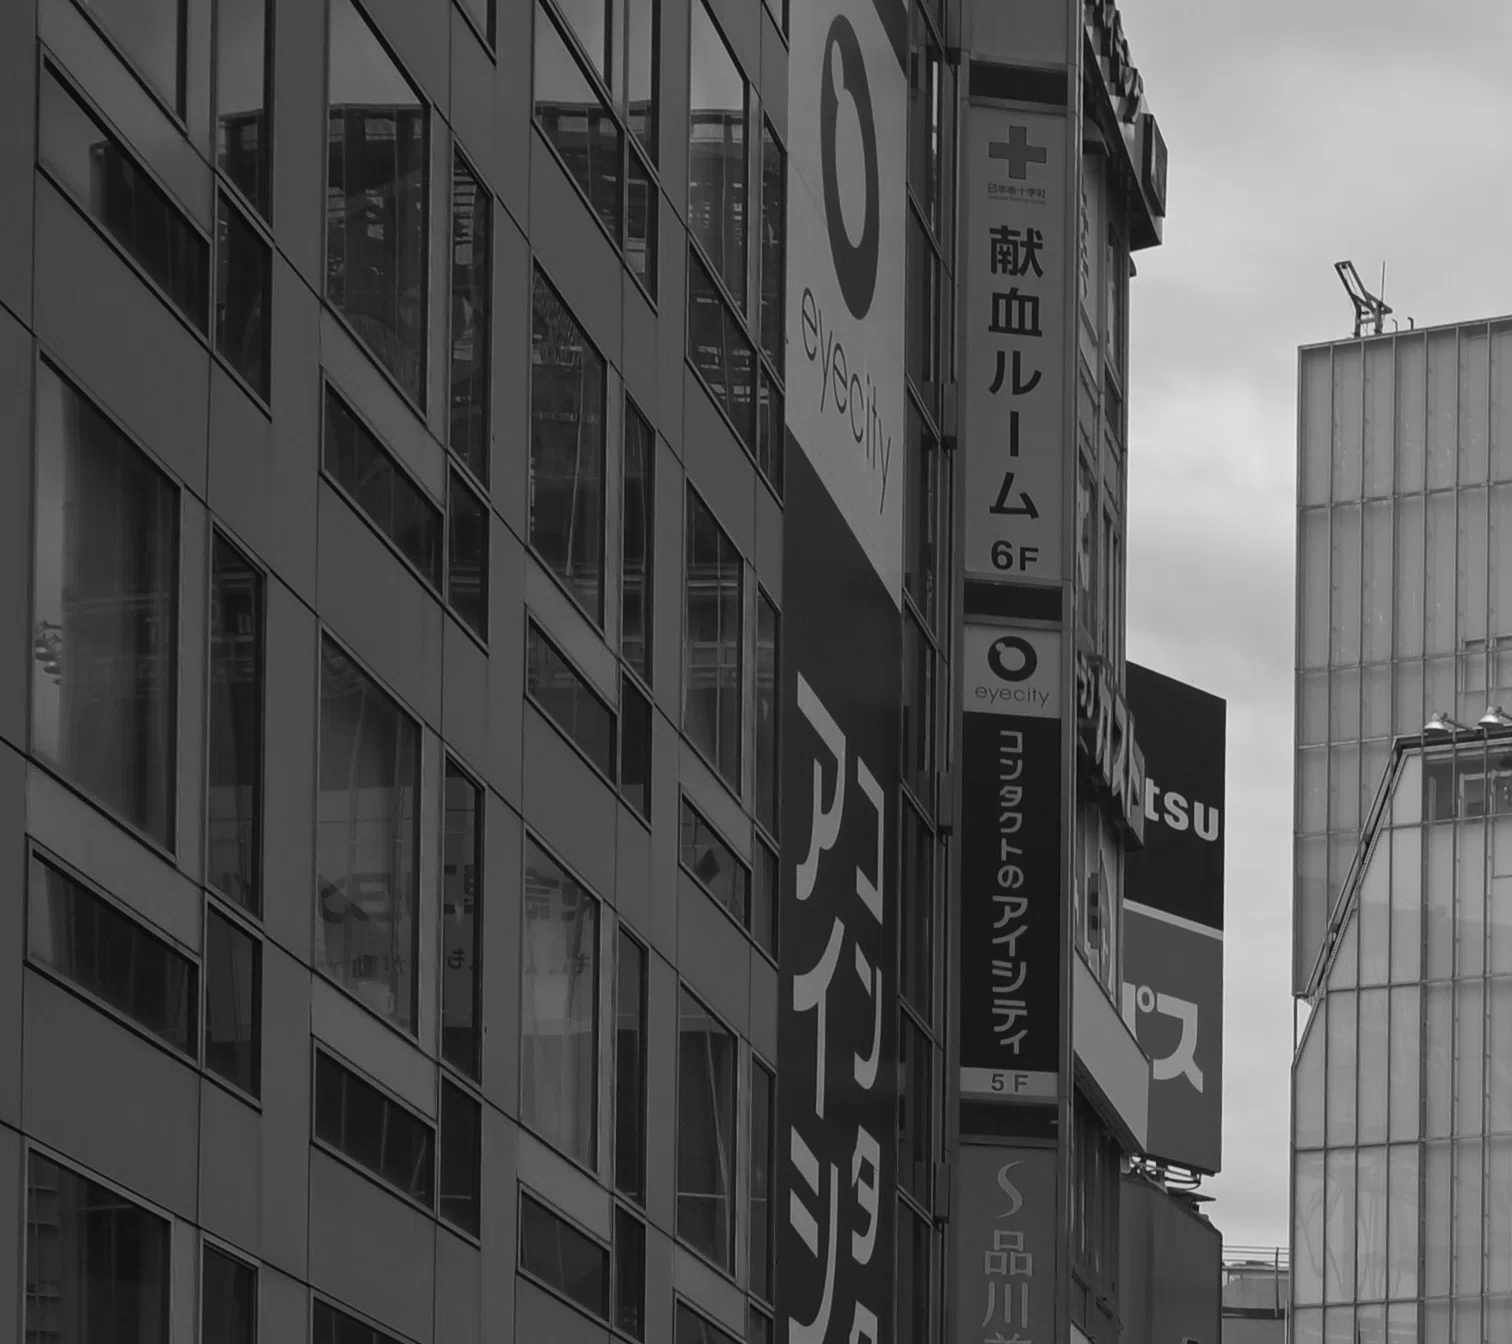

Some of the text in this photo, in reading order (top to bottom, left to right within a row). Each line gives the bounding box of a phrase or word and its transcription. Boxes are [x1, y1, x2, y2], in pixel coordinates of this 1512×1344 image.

[801, 287, 890, 514] eyecity
[988, 225, 1043, 519] 献血ルーム
[990, 540, 1039, 571] 6F
[974, 684, 1050, 708] eyecity
[1144, 777, 1219, 843] tsu
[991, 730, 1028, 1055] コンタクトのアイシティ
[991, 1072, 1028, 1092] 5F
